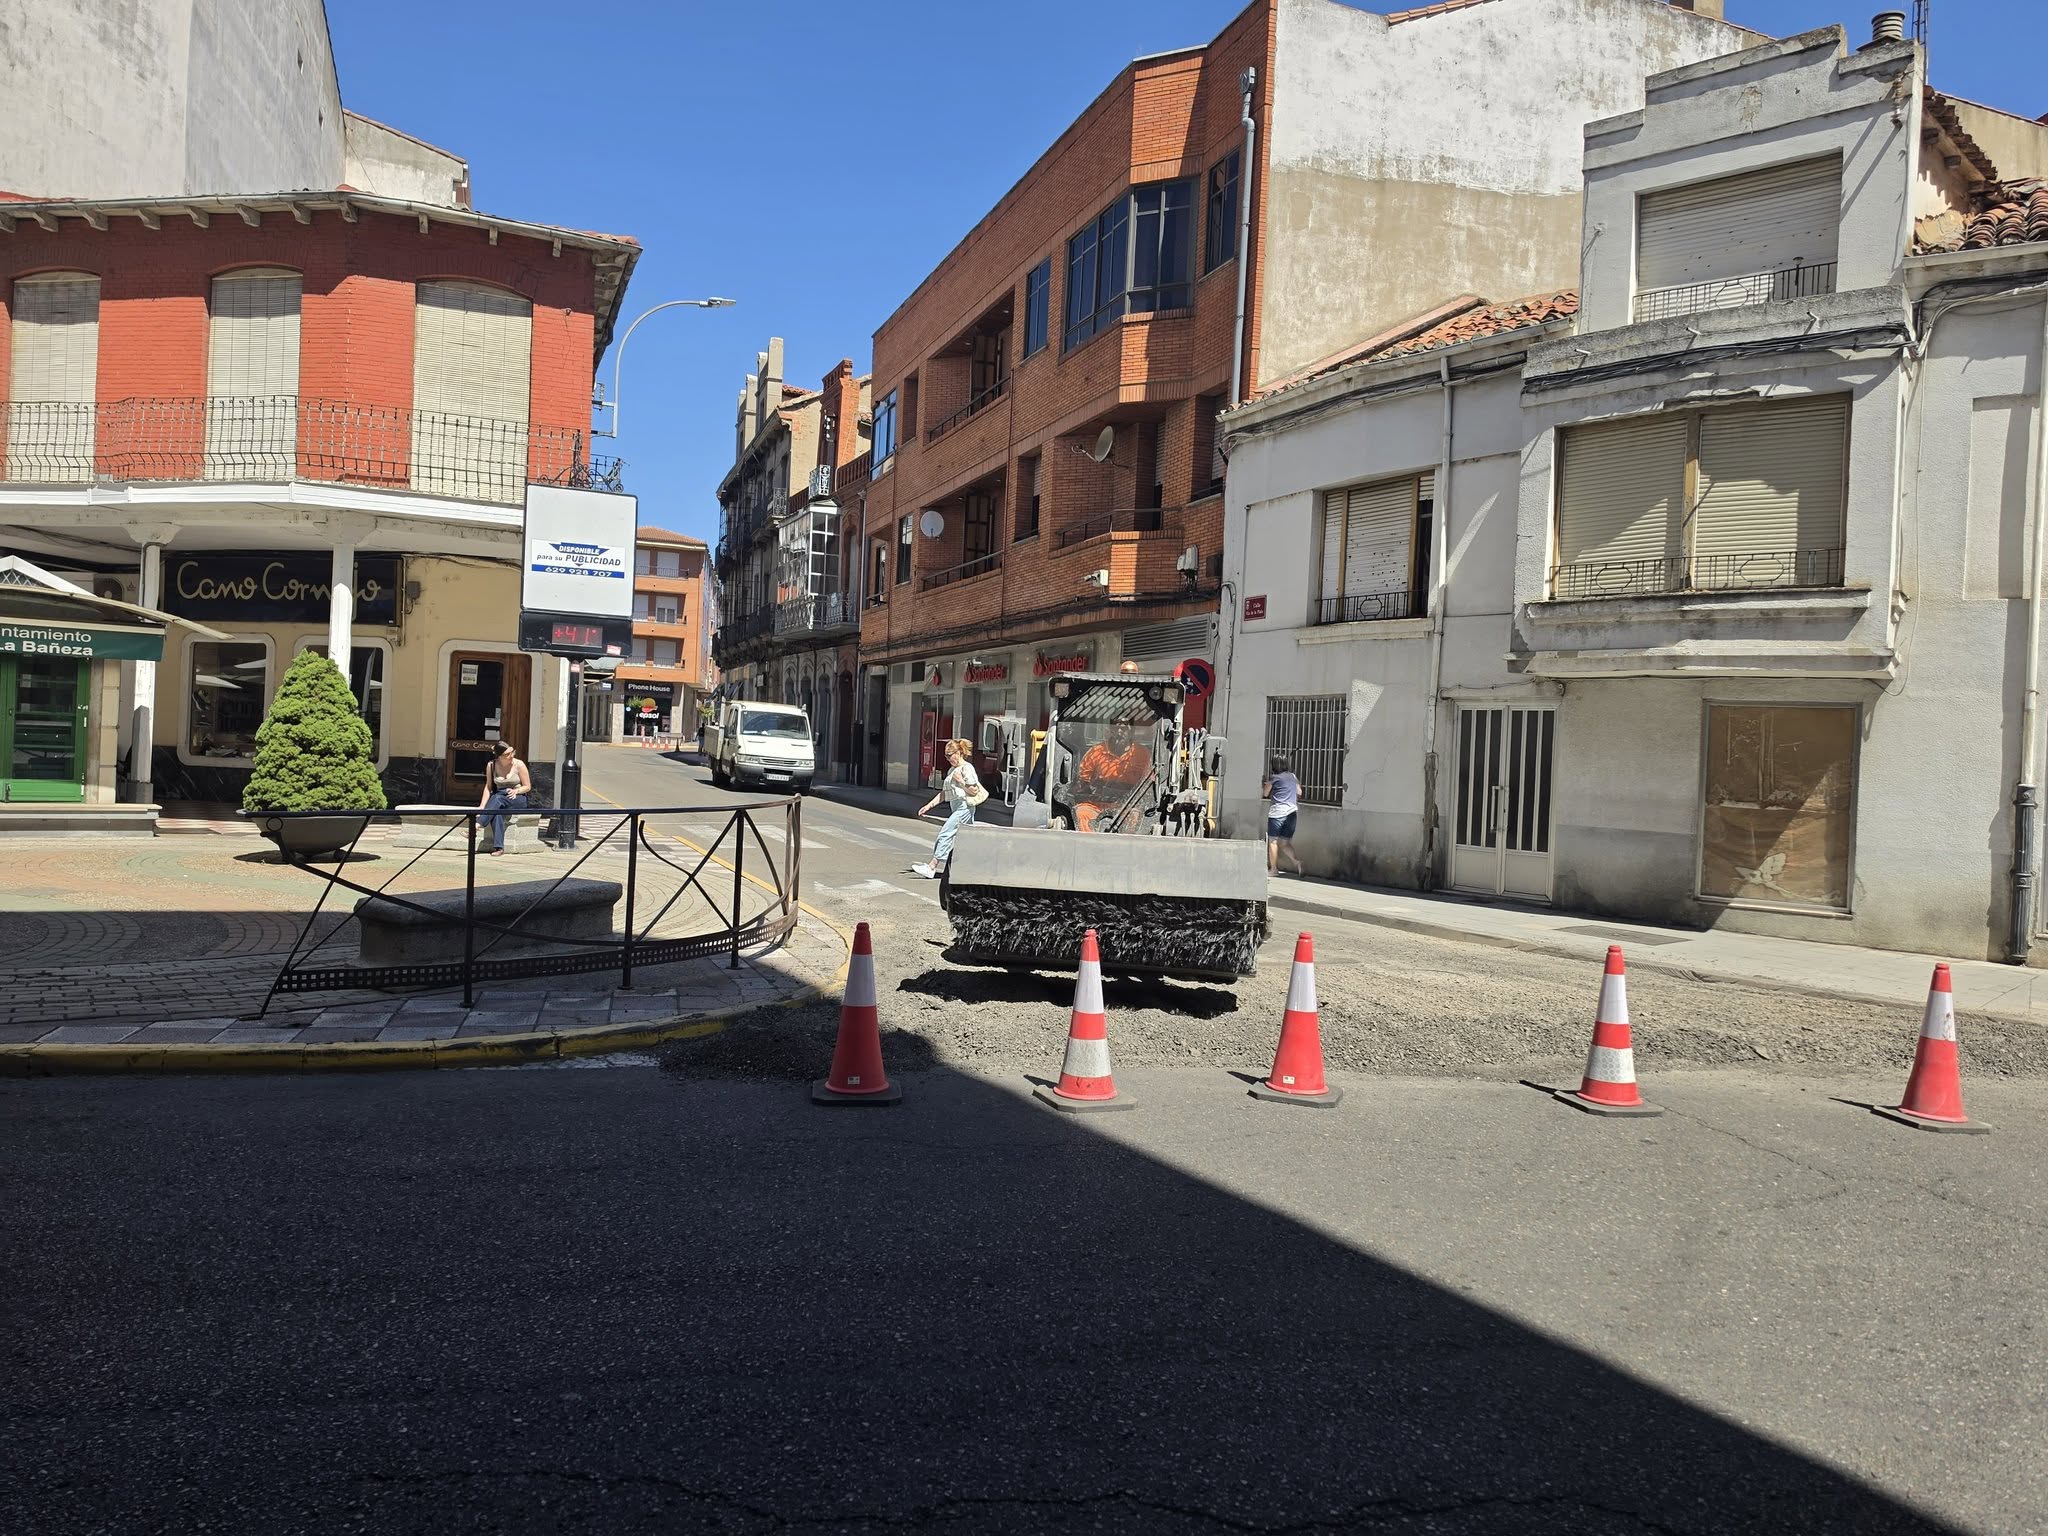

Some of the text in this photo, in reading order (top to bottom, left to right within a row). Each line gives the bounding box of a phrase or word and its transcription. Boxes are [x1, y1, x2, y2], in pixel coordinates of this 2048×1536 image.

[559, 545, 601, 555] DISPONIBLE
[566, 554, 621, 566] PUBLICIDAD
[177, 561, 381, 621] Cano Cornjo
[1, 627, 92, 643] ntamiento
[22, 640, 93, 656] Bañeza
[1043, 656, 1087, 674] Santander
[971, 665, 1007, 682] Santander
